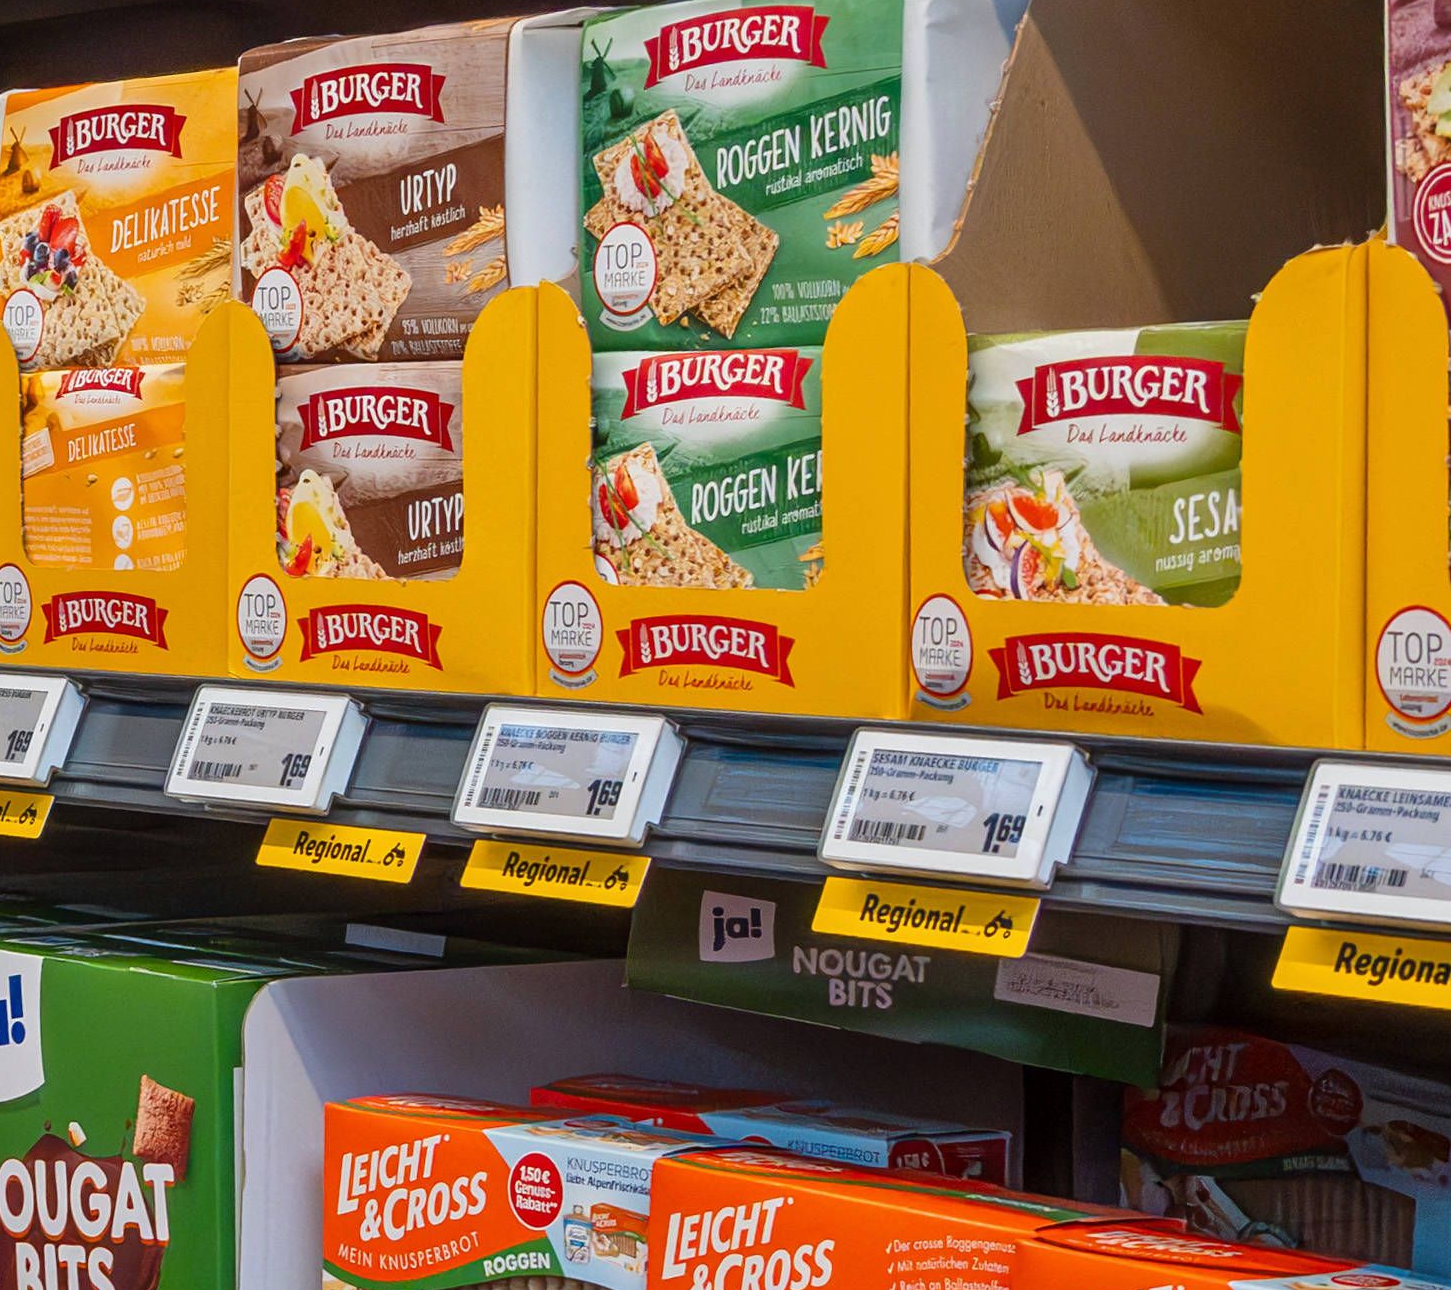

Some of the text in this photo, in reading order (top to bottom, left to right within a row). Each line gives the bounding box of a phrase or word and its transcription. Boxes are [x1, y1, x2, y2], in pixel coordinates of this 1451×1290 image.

[716, 96, 892, 191] ROGGEN KERNIG
[400, 163, 457, 213] URTYP
[765, 152, 864, 199] rustikal aromatisch
[111, 186, 220, 254] DELIKATESSE
[389, 205, 466, 241] herzhaft köstlich
[1387, 630, 1443, 667] TOP
[1389, 665, 1450, 691] MARKE
[872, 750, 951, 771] SESAM KNAECKE
[1338, 787, 1389, 803] KNAECKE
[292, 831, 371, 864] Regional
[982, 812, 1027, 853] 1.69
[859, 894, 964, 935] Regional
[897, 1259, 1010, 1276] Mit natürlichen Zutaten
